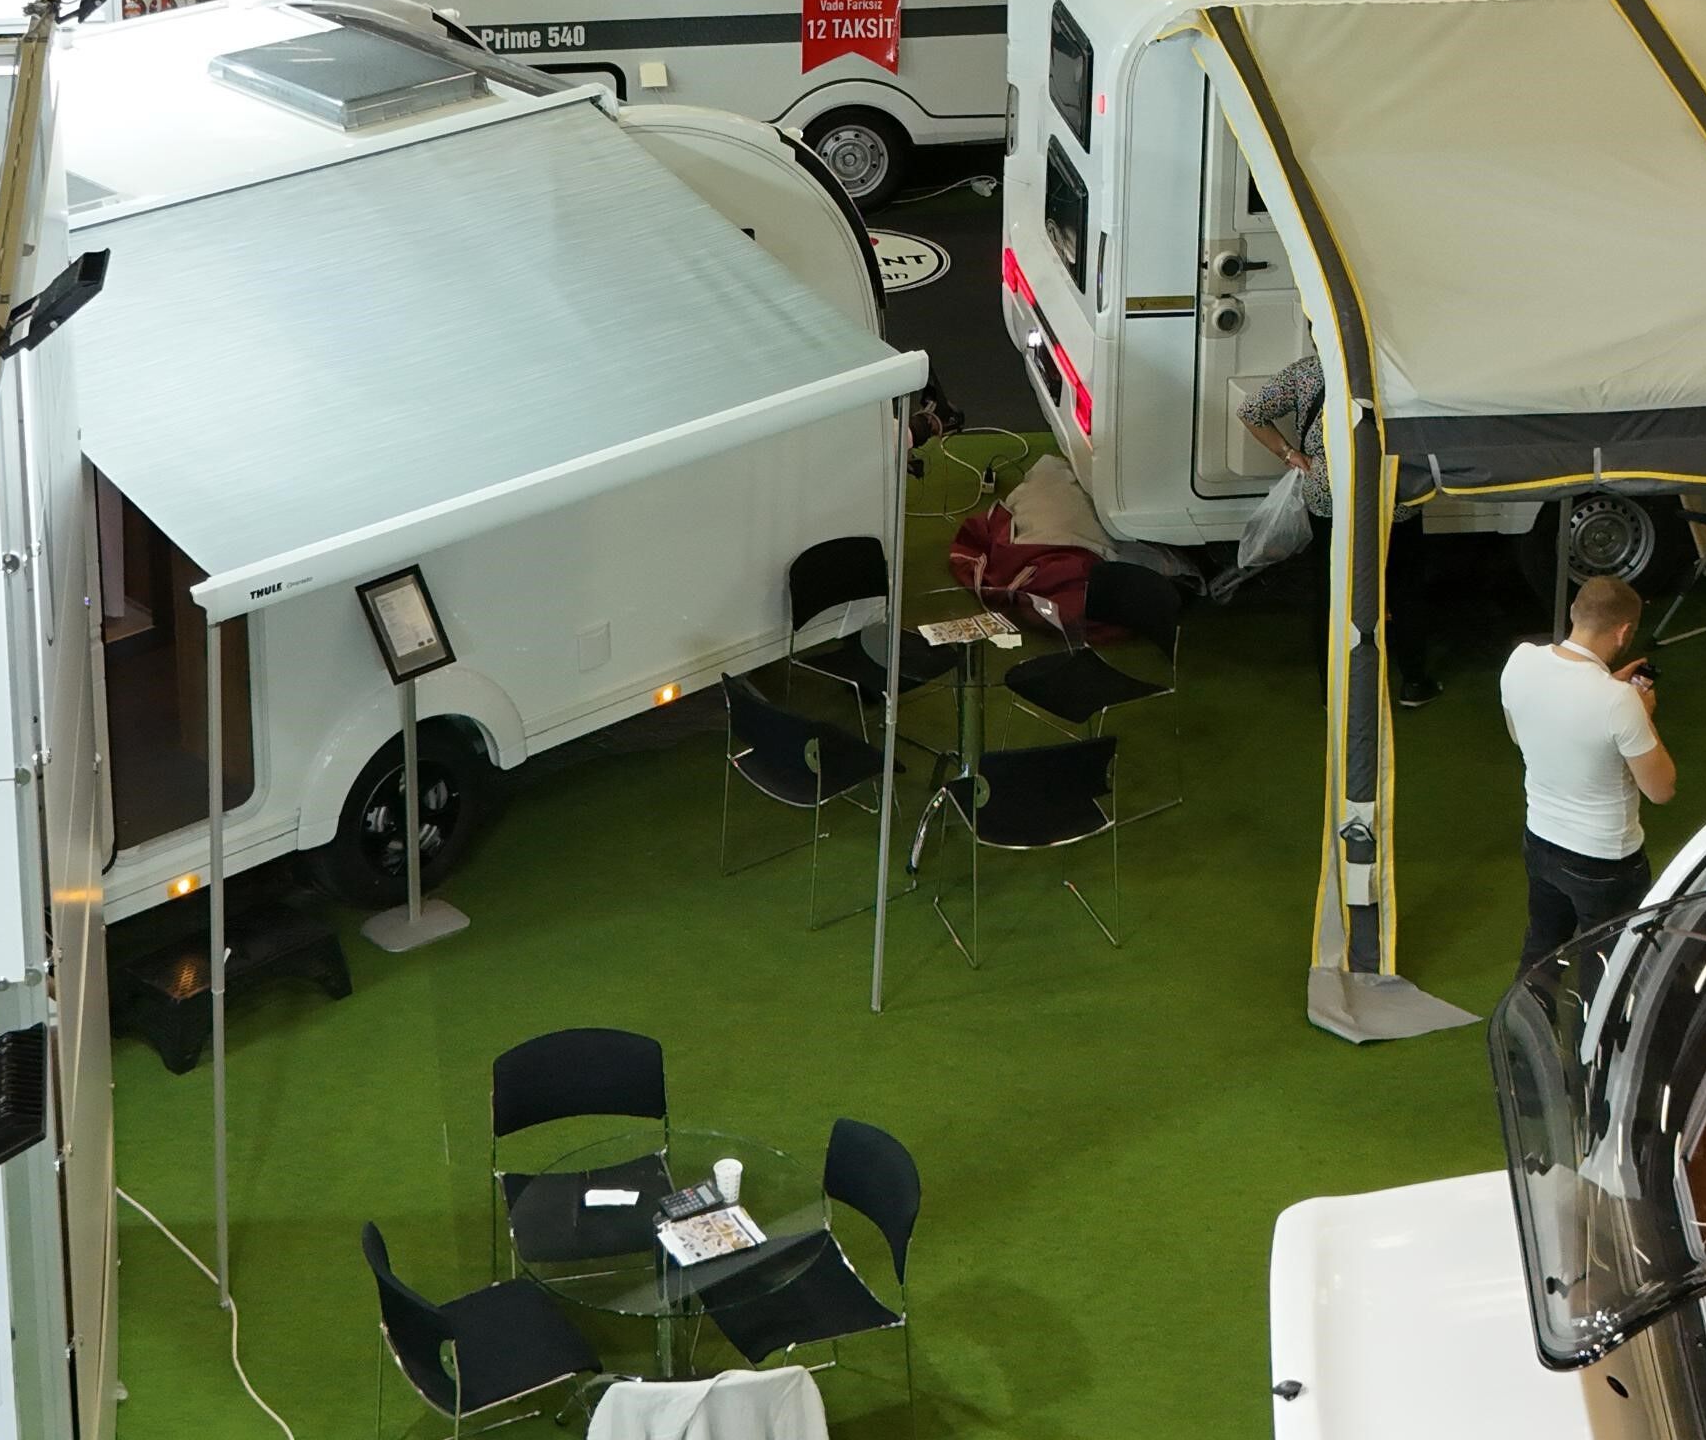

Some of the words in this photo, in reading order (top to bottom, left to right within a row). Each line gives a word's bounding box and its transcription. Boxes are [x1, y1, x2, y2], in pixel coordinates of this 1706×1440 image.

[820, 0, 844, 12] Vade
[806, 19, 827, 40] 12
[831, 13, 895, 40] TAKSİT
[480, 28, 541, 50] Prime
[547, 25, 585, 48] 540
[250, 582, 283, 600] THULE
